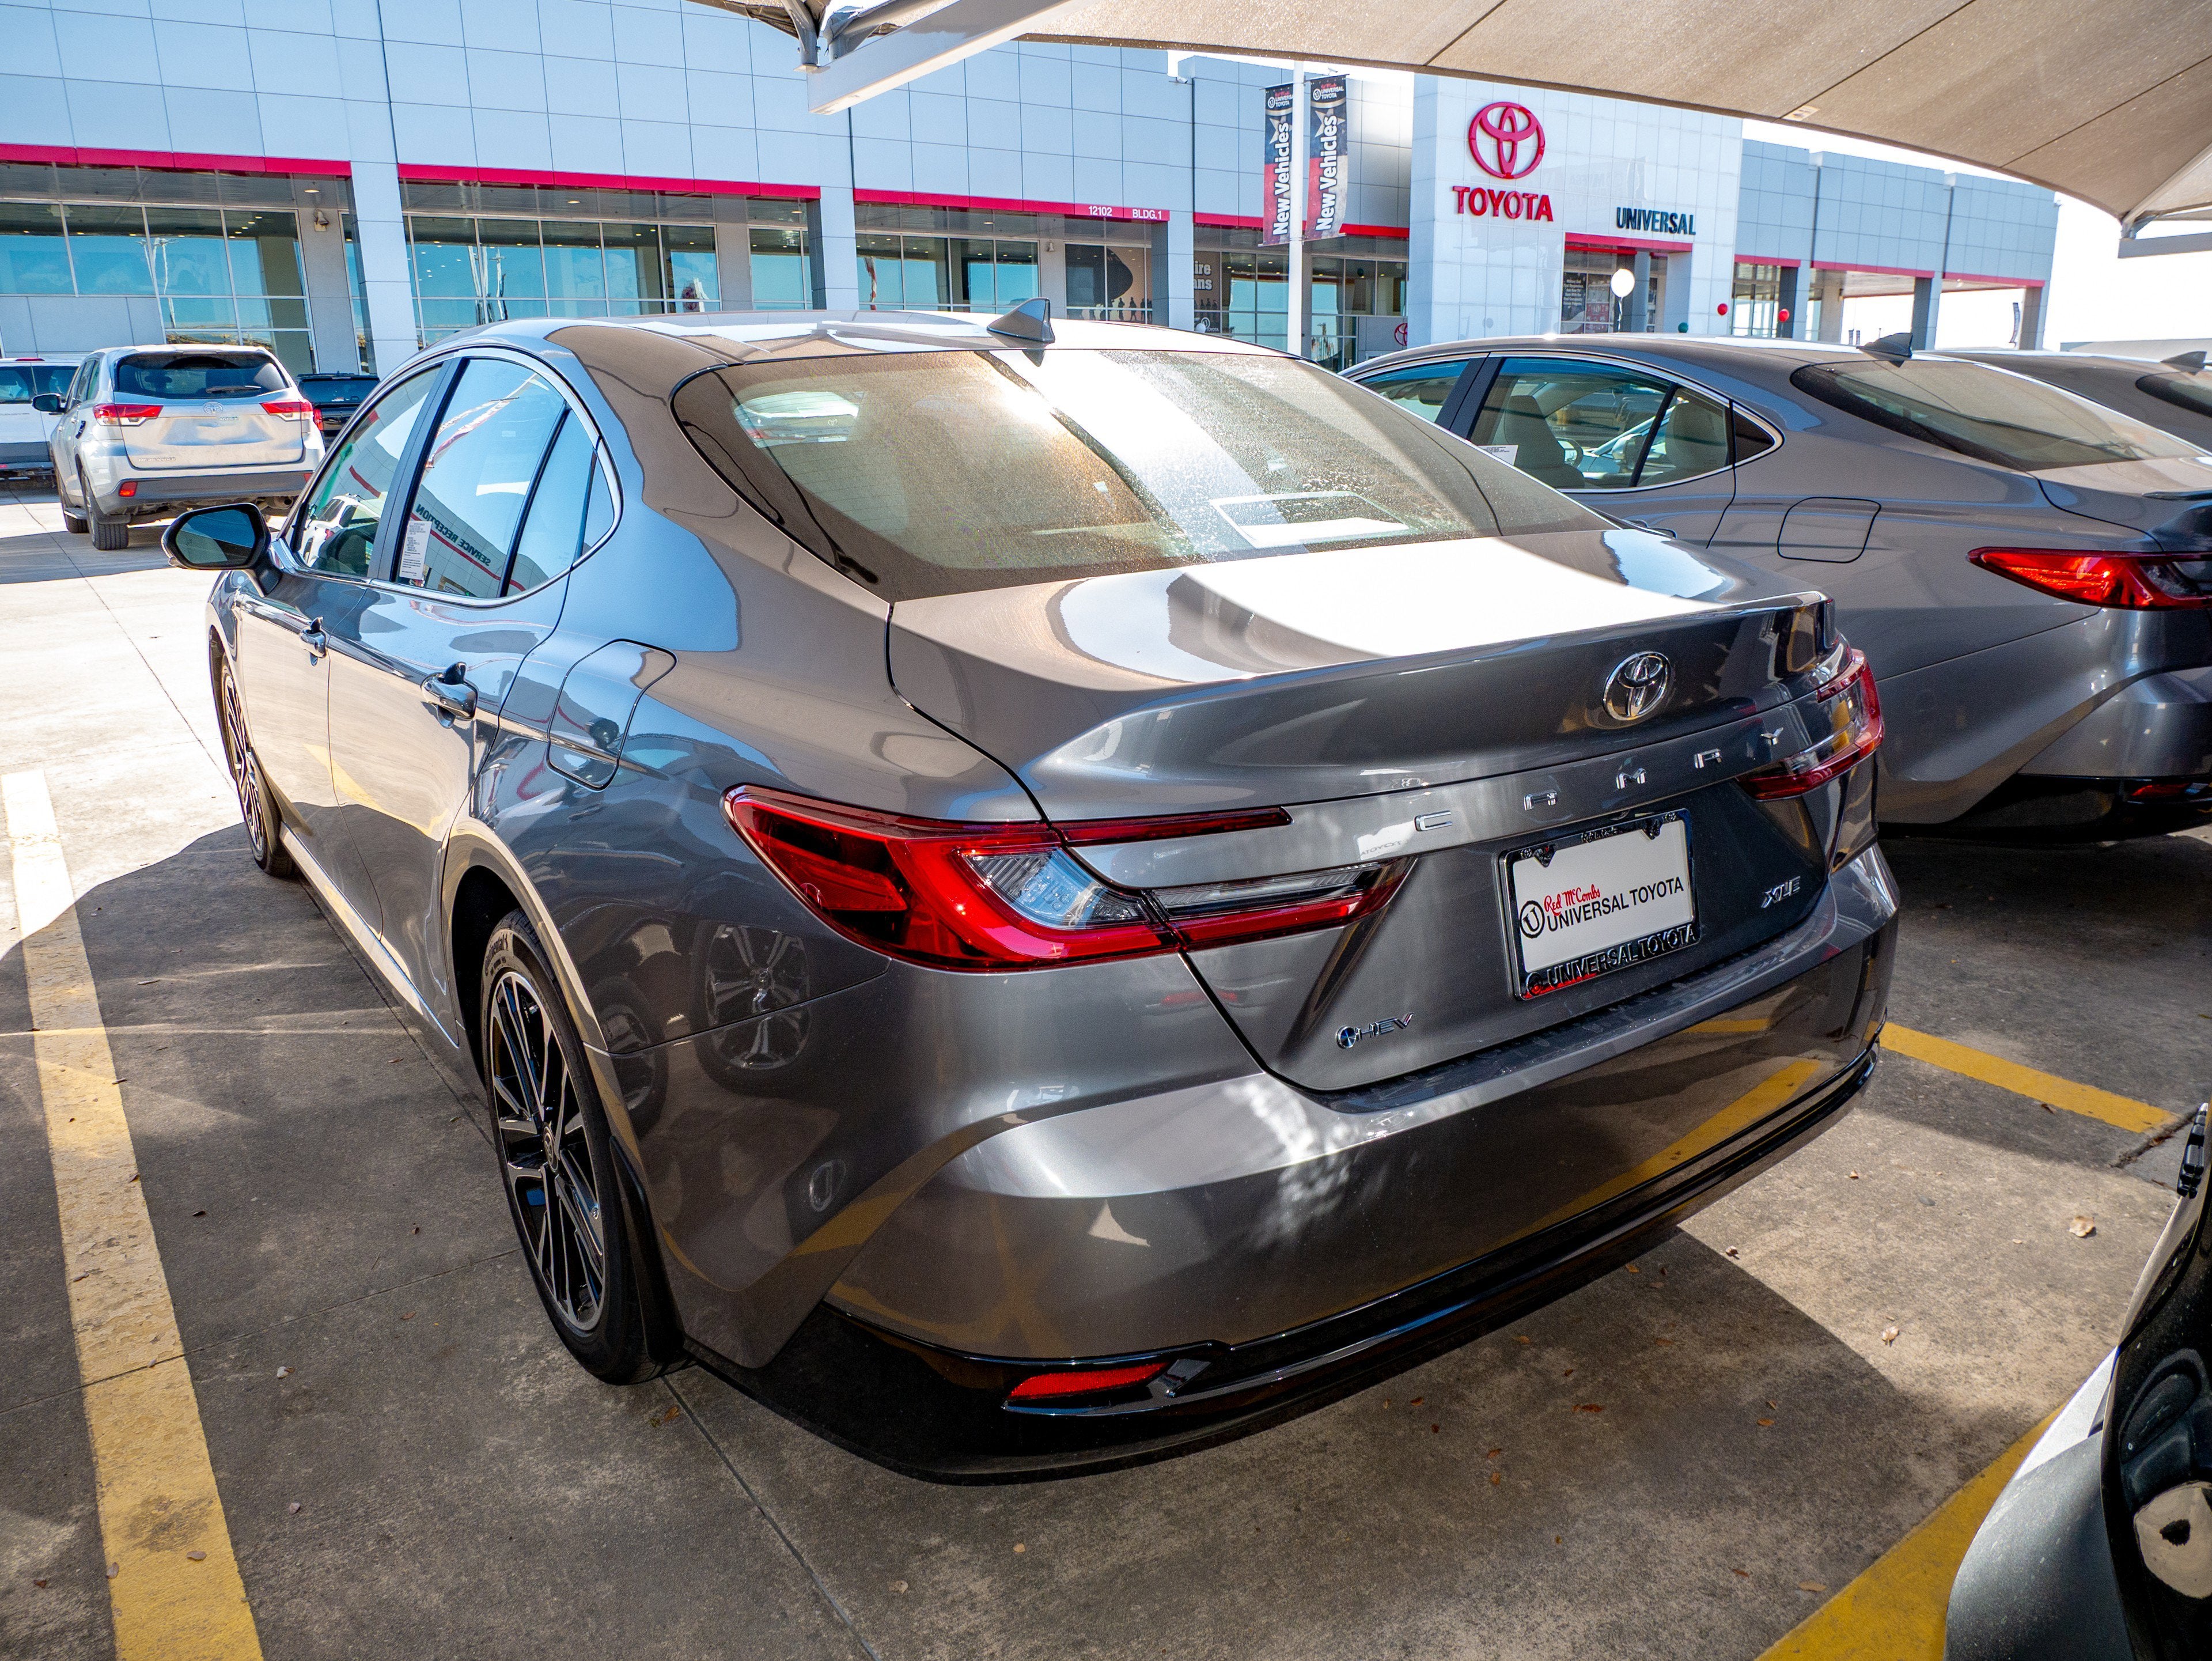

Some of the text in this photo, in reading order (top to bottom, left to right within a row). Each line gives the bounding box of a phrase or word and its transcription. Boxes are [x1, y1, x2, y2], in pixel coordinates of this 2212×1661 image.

[1275, 94, 1293, 103] UNIVERSA
[1321, 86, 1344, 94] UNIVERSAL
[1272, 122, 1290, 235] New Vehicles
[1315, 115, 1337, 230] New Vehicles
[1088, 206, 1112, 217] 12102
[1452, 186, 1554, 222] TOYOTA
[1616, 207, 1696, 236] UNIVERSAL
[1544, 892, 1562, 916] Red
[1547, 877, 1684, 932] UNIVERSAL TOYOTA
[1761, 876, 1801, 908] XLE
[1547, 924, 1696, 987] UNIVERSAL TOYOTA
